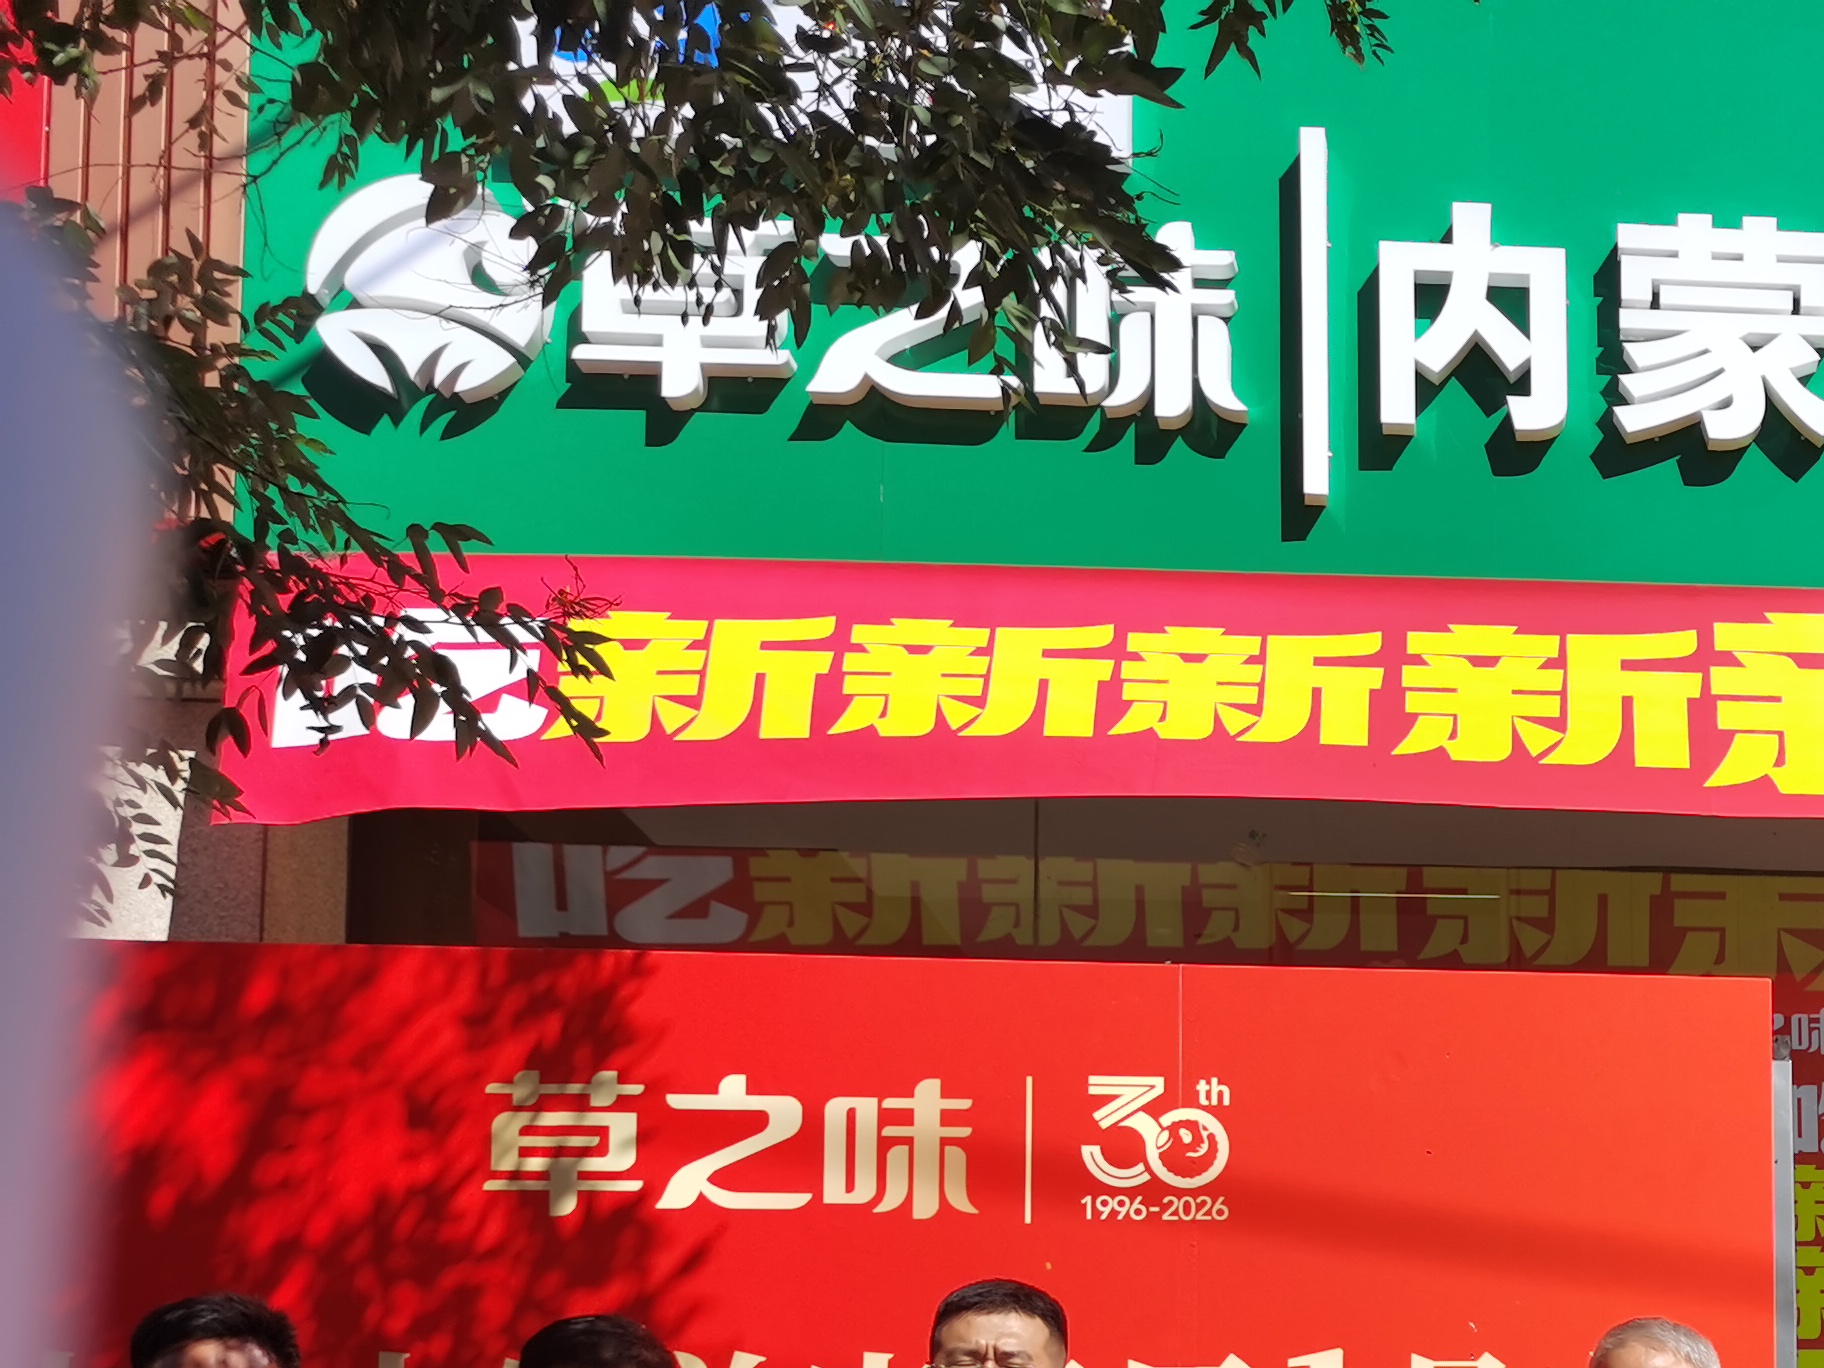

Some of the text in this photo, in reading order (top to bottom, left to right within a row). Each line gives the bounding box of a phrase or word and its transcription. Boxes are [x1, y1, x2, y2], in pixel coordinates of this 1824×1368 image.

[482, 1070, 979, 1219] 草之味
[1081, 1195, 1230, 1221] 1996-2026
